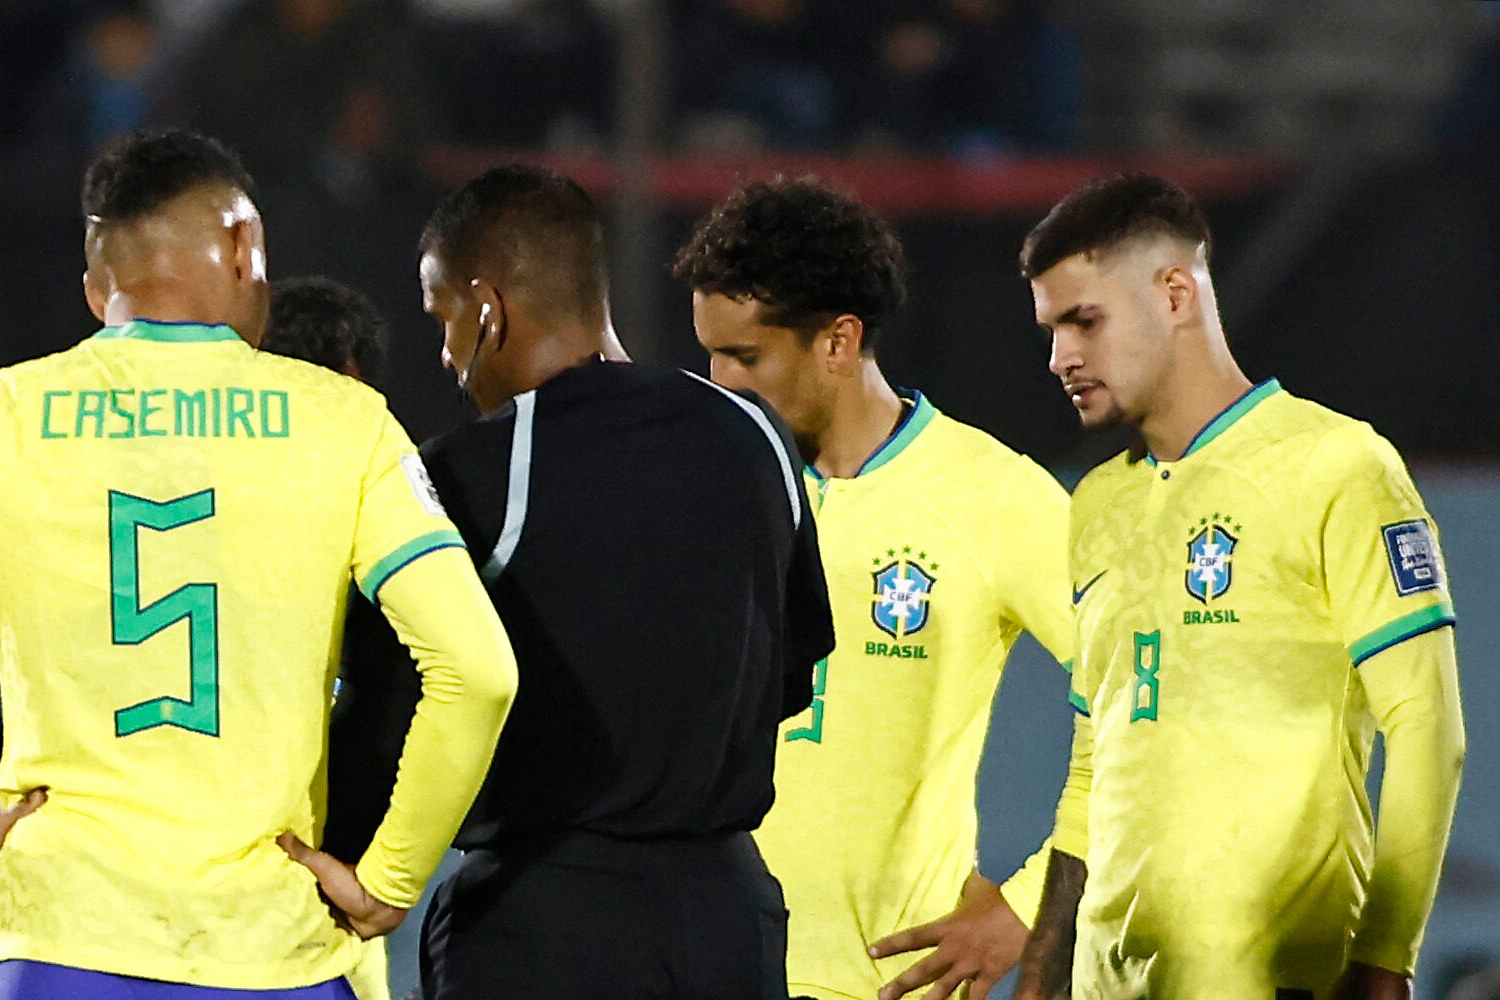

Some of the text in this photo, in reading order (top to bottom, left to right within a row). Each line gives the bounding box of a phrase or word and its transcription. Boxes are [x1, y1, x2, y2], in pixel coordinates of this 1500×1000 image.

[40, 387, 290, 439] CASEMIRO
[107, 487, 220, 738] 5
[1183, 609, 1240, 625] BRASIL
[864, 641, 929, 659] BRASIL
[1130, 629, 1161, 724] 8
